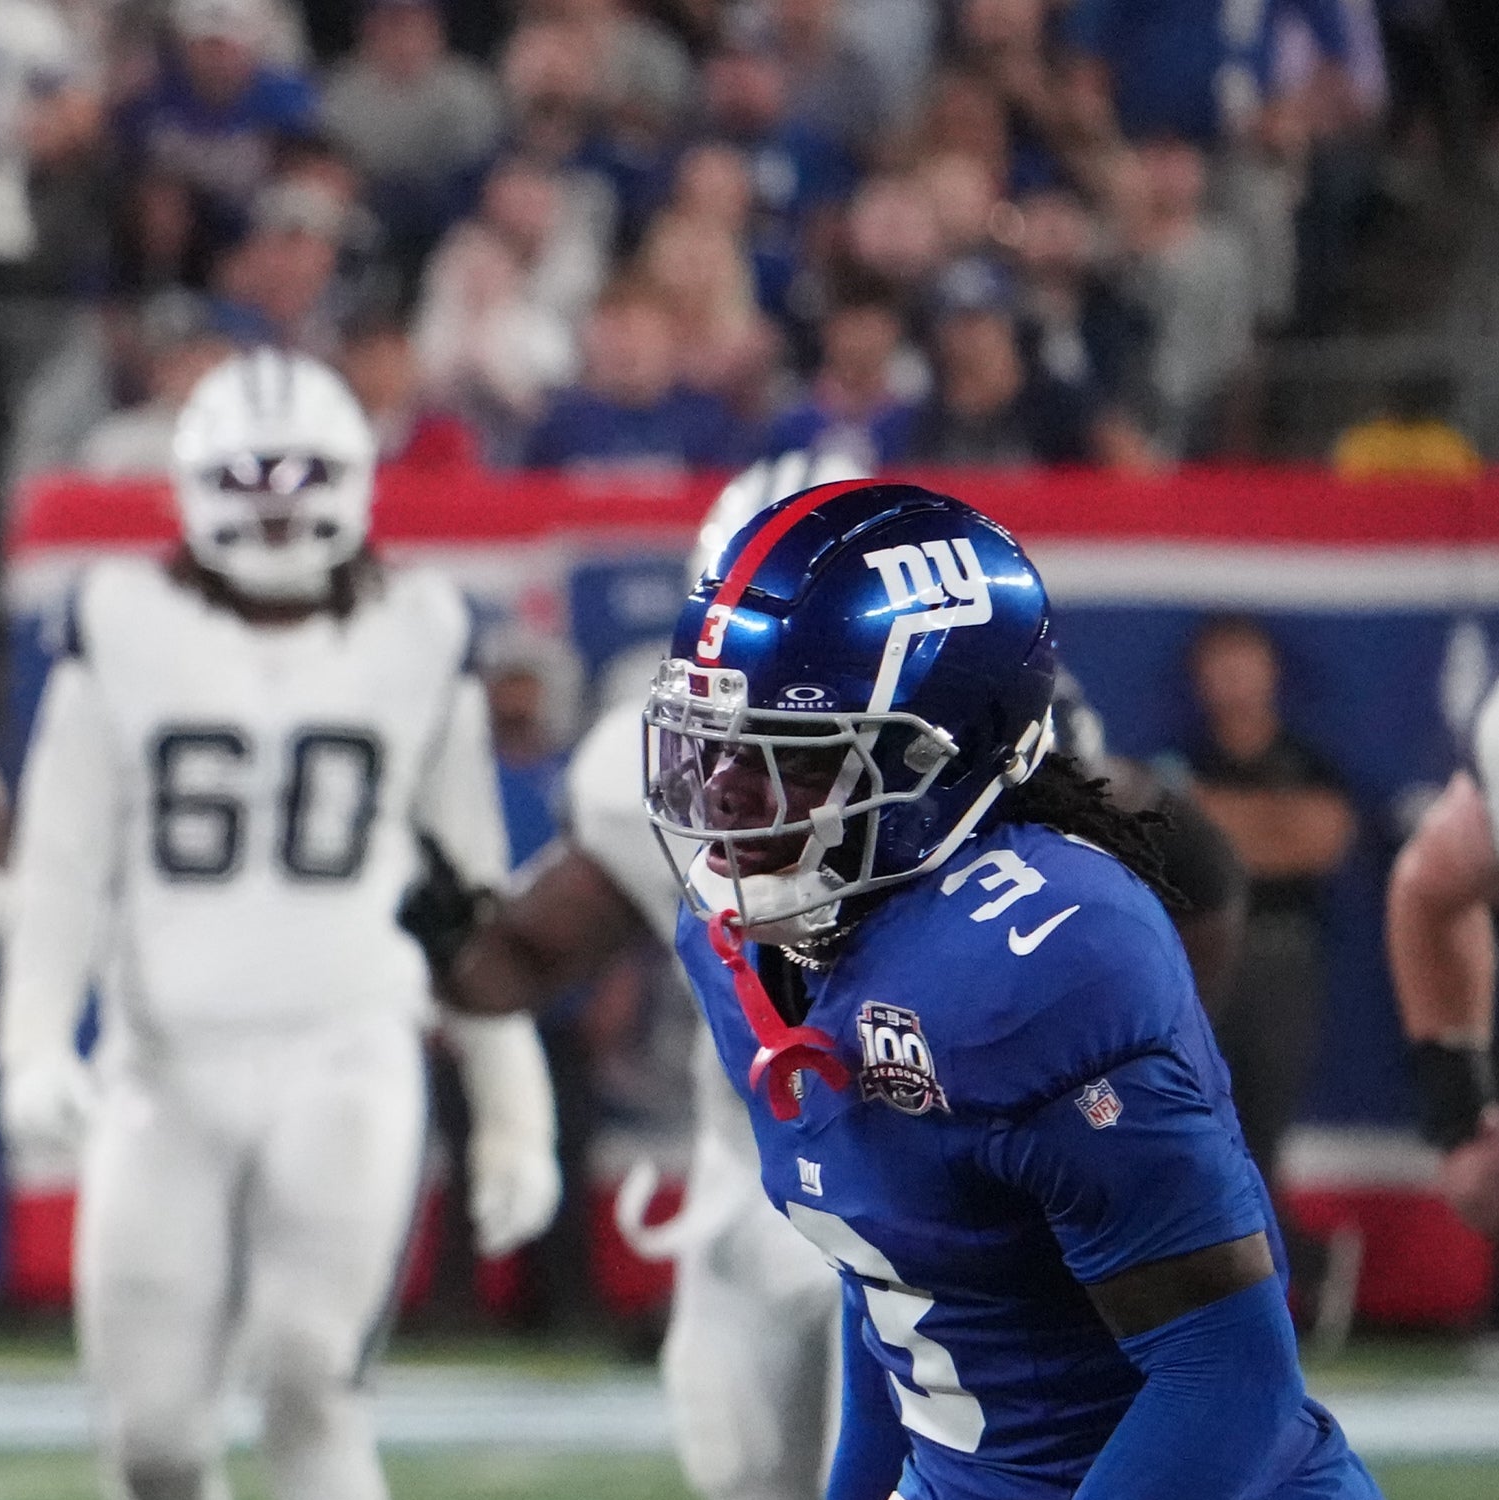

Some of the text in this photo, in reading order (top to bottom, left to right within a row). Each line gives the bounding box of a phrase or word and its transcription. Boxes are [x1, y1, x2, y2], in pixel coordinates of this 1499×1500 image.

[696, 603, 732, 660] 3
[777, 701, 834, 709] OAKLEY
[152, 728, 380, 876] 60
[939, 849, 1048, 923] 3
[861, 1022, 931, 1078] 100
[871, 1066, 931, 1088] SEASONS
[1088, 1096, 1121, 1125] NFL
